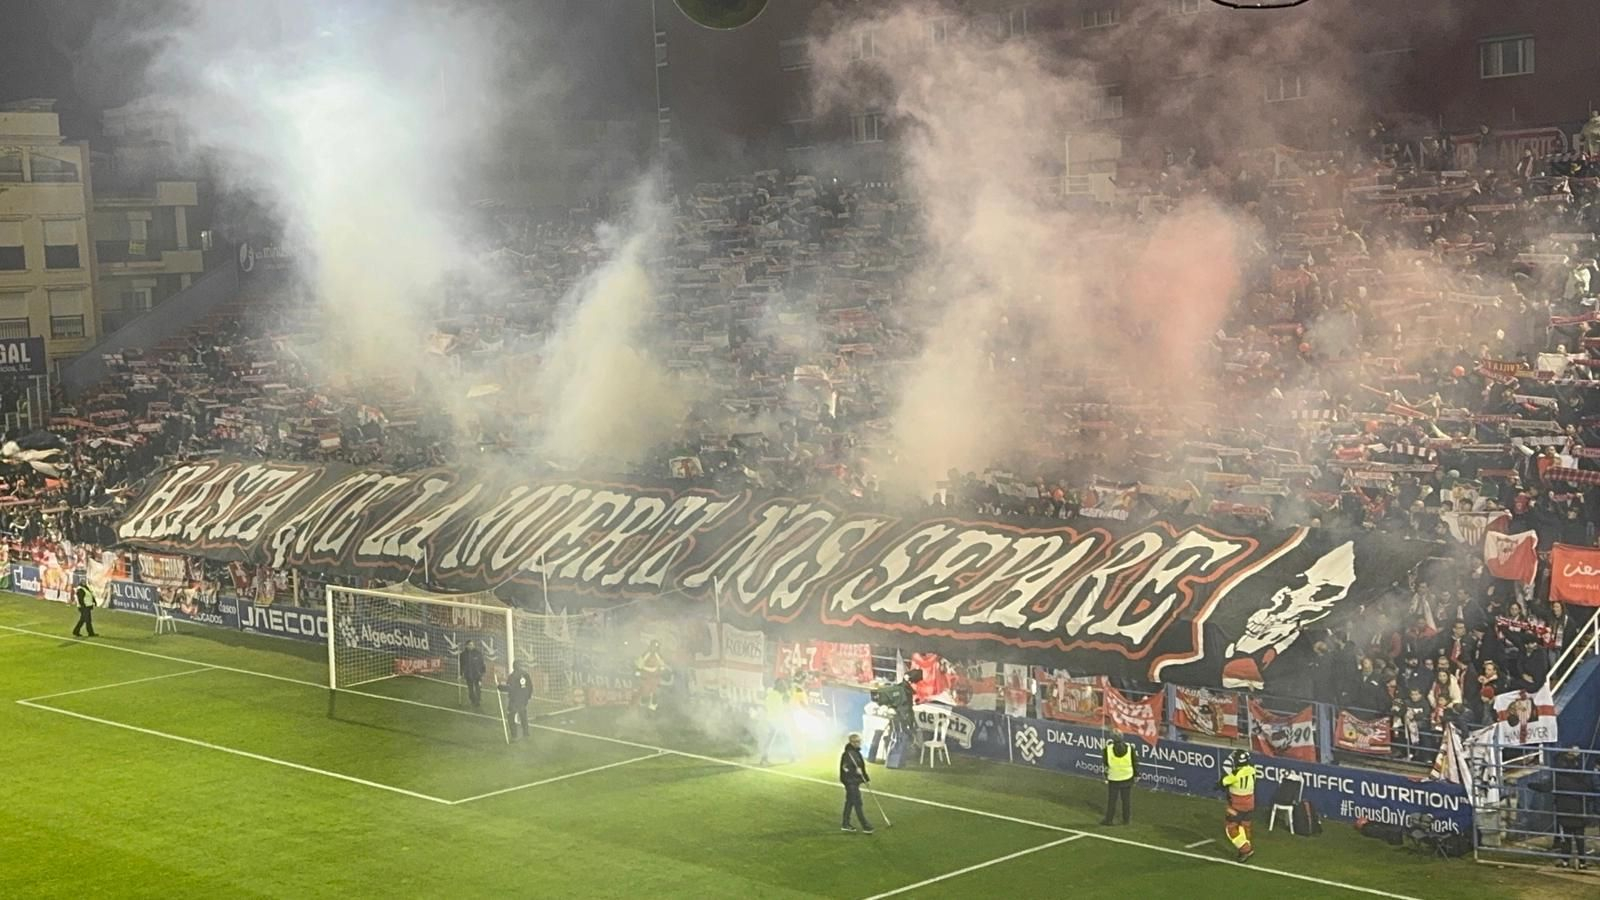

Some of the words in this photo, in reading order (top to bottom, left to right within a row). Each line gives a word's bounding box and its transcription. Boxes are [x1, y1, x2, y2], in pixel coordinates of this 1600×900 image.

[119, 465, 315, 541] HASTA
[272, 473, 411, 568] QUE
[358, 478, 482, 562] LA
[440, 484, 740, 588] MUERTE
[684, 503, 882, 609] NOS
[831, 524, 1240, 644] SEPARE
[124, 584, 151, 602] CLINIC
[361, 624, 430, 650] AlgeaSalud
[919, 711, 935, 724] de
[1141, 744, 1215, 769] PANADERO
